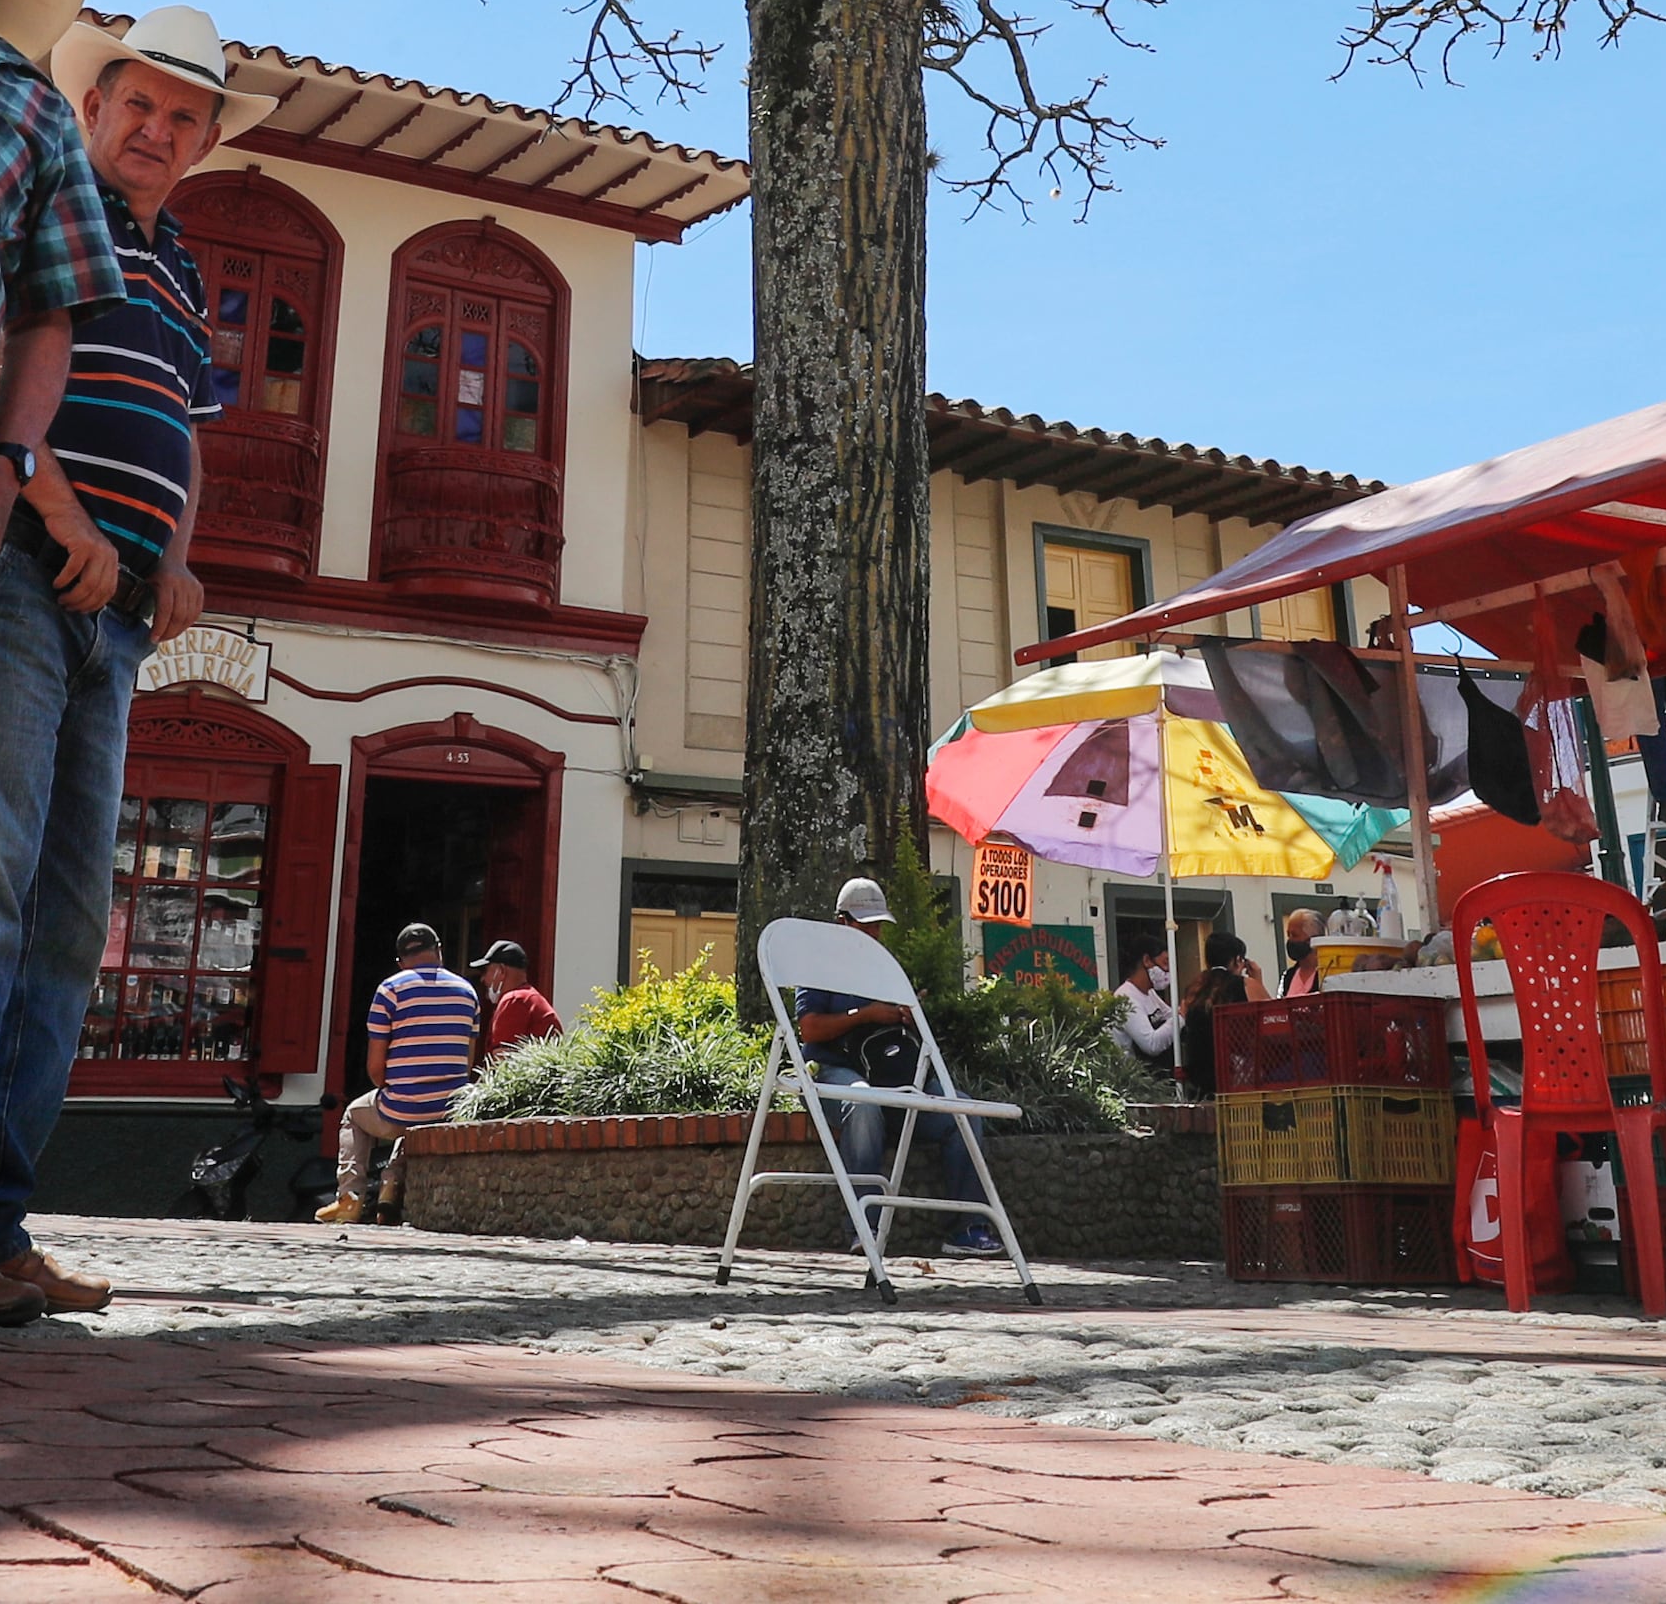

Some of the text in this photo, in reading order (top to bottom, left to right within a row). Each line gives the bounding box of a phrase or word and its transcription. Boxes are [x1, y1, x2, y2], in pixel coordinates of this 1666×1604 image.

[156, 629, 258, 667] MERCADO
[146, 656, 255, 696] PIELROJA
[980, 864, 1028, 881] OPERADORES
[981, 849, 1029, 866] A TODOS LOS
[978, 880, 1026, 918] $100
